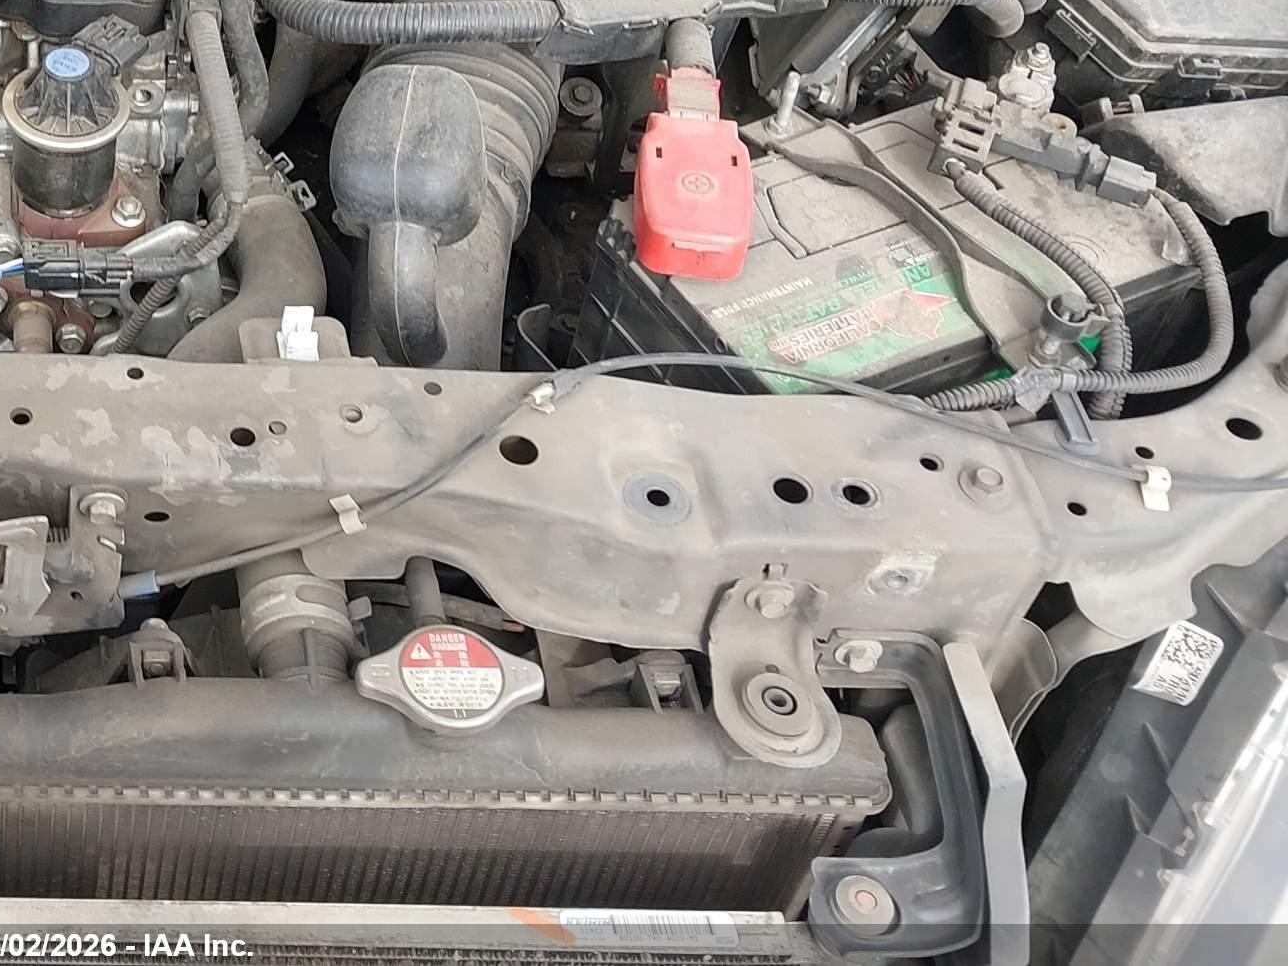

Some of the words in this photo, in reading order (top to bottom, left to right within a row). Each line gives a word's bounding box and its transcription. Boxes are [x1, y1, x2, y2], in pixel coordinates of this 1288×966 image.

[780, 317, 884, 364] CALIFORNIA
[791, 306, 875, 348] BATTERIES
[429, 633, 466, 643] DANGER
